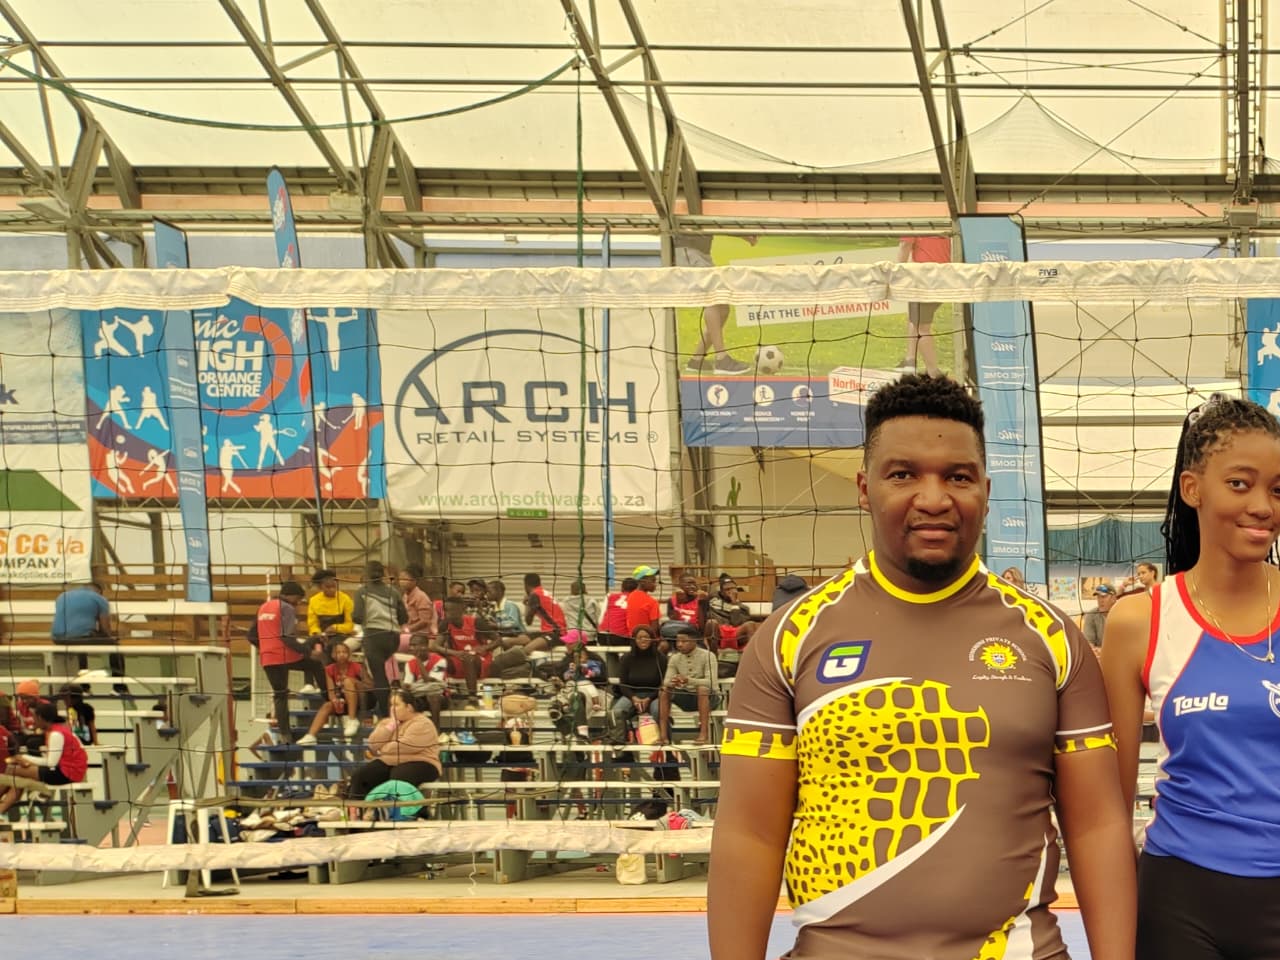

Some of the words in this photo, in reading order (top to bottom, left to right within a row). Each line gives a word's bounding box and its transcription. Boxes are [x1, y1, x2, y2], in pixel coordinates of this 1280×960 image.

[747, 310, 778, 321] BEAT
[779, 308, 801, 319] THE
[801, 301, 890, 317] INFLAMMATION
[206, 384, 261, 397] CENTRE
[832, 377, 867, 391] Norflex
[408, 372, 638, 425] ARCH
[416, 431, 505, 445] RETAIL
[516, 429, 639, 444] SYSTEMS
[0, 558, 60, 569] MPANY
[1172, 692, 1229, 717] Tayla
